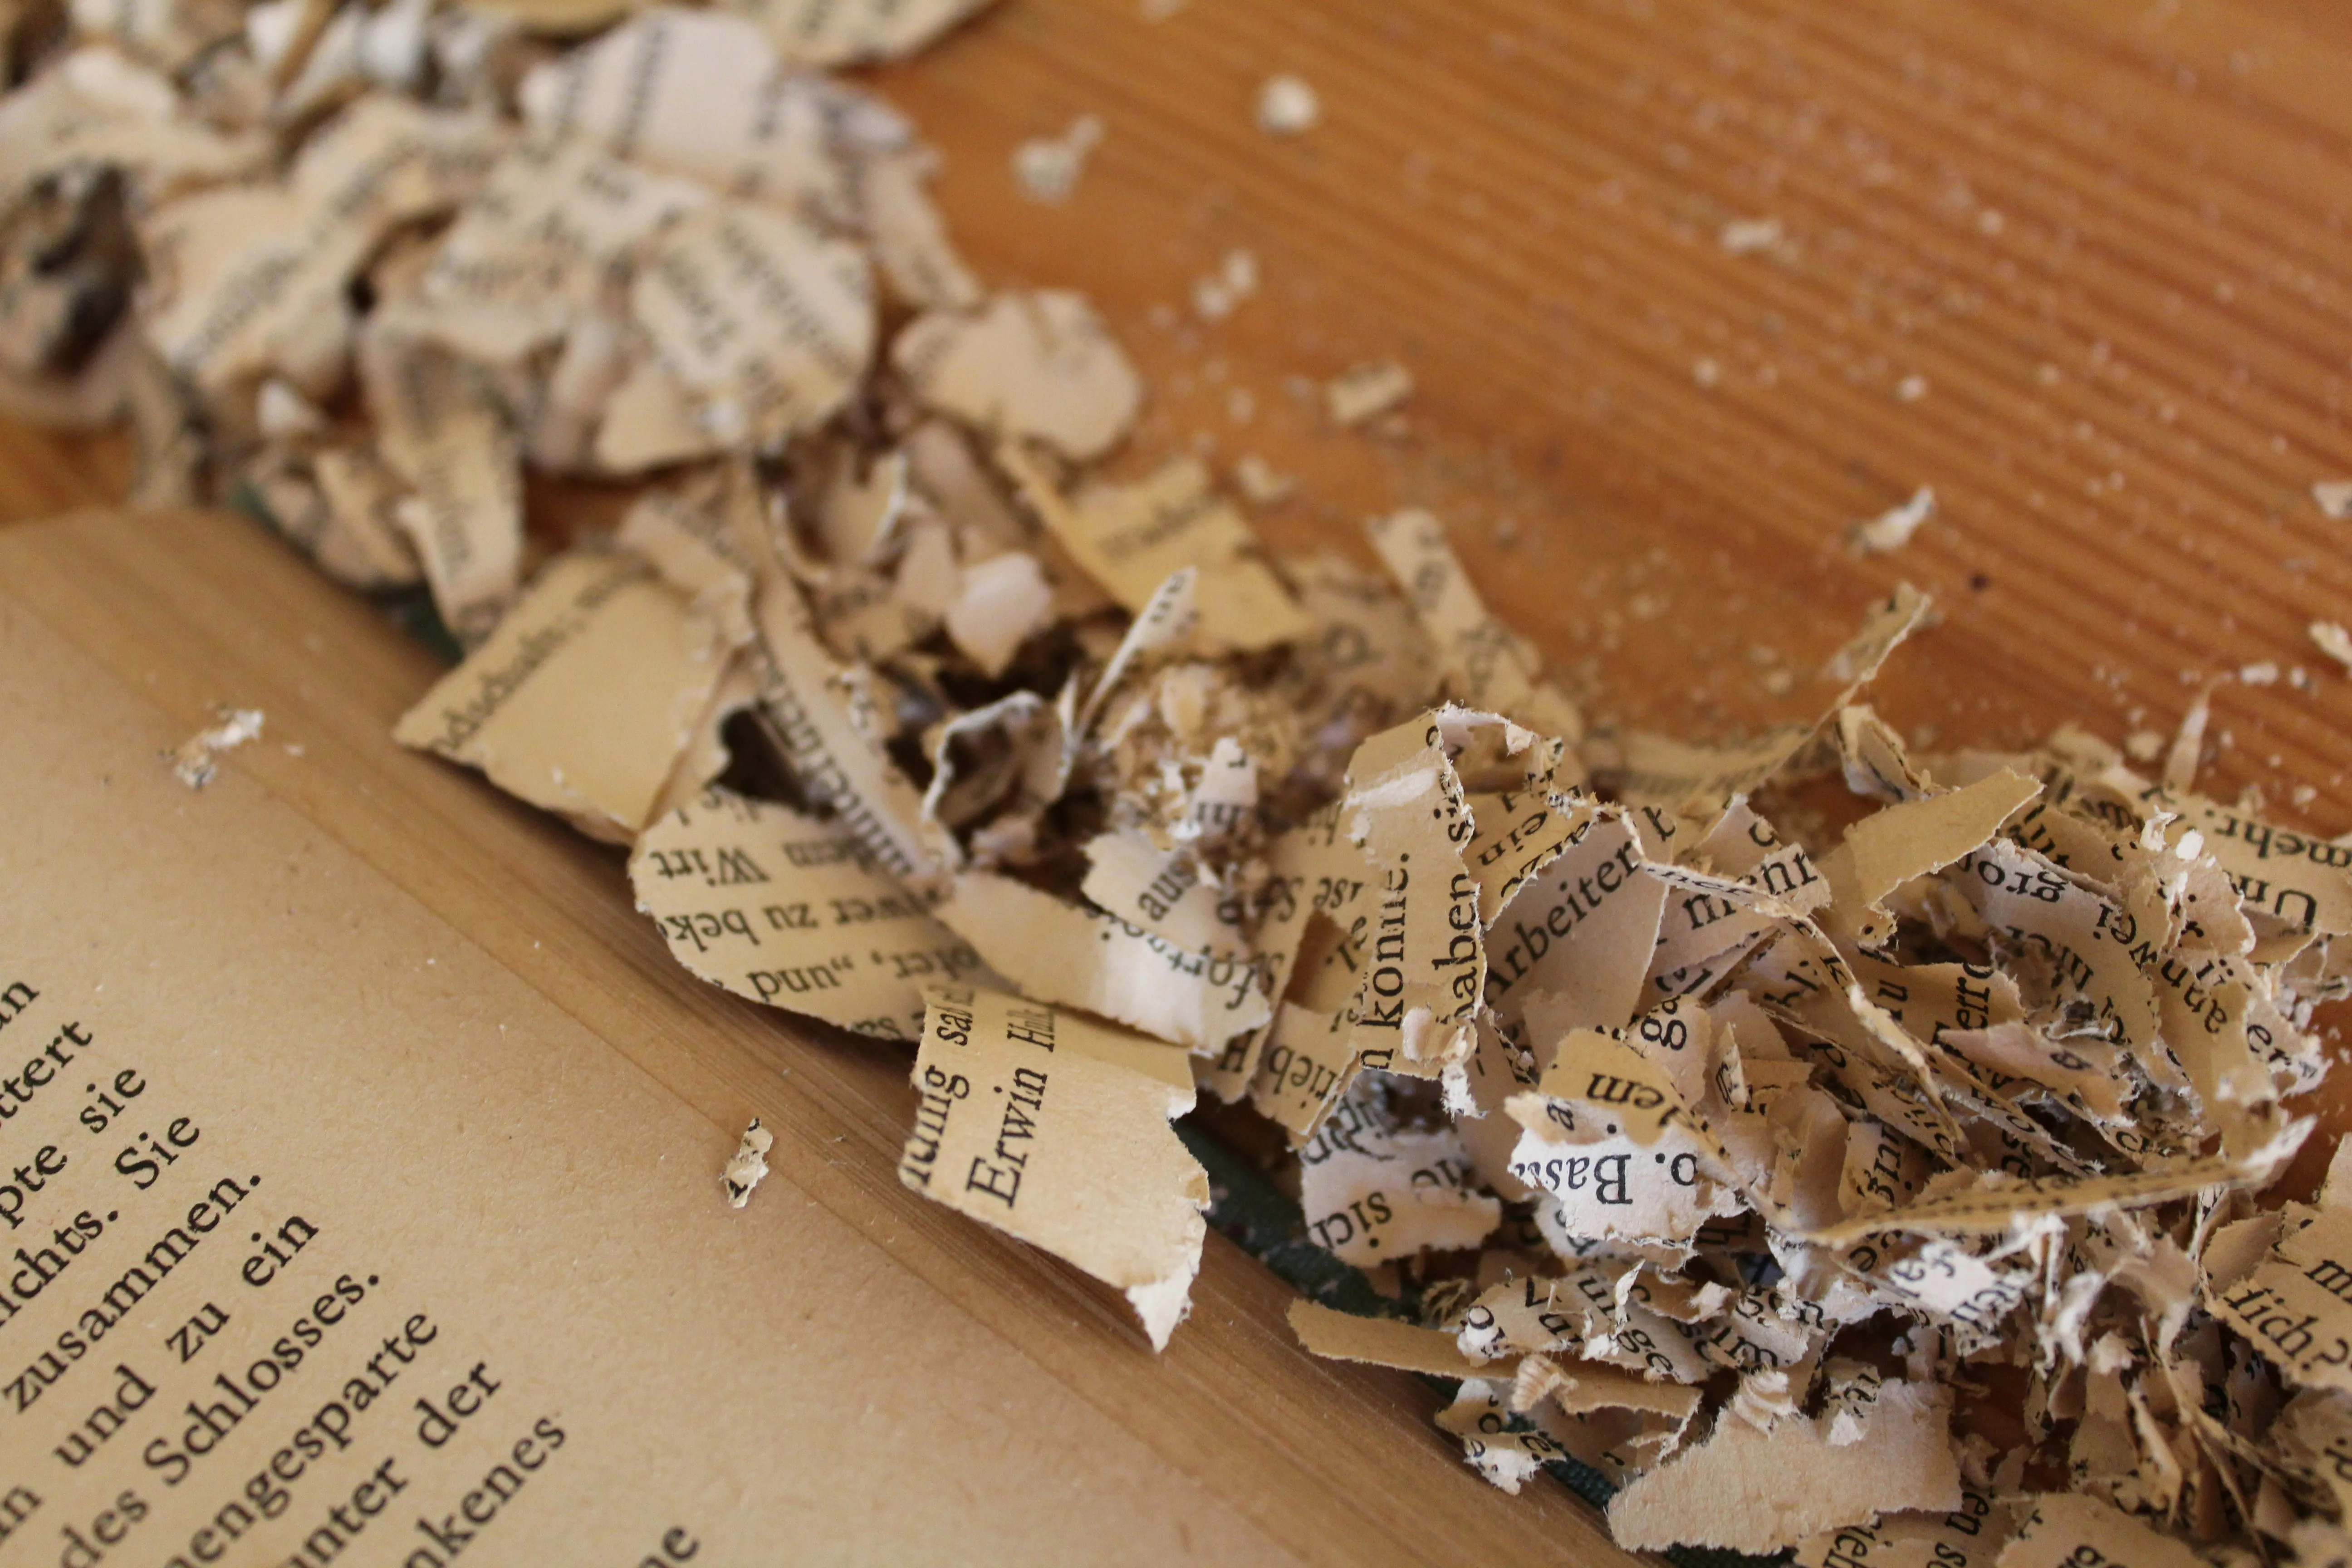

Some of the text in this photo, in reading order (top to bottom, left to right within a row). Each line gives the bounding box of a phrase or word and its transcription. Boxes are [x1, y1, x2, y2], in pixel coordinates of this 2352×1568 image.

[649, 846, 770, 887] Wirt
[80, 1069, 147, 1134] sie
[114, 1116, 200, 1191] Sie
[965, 1066, 1049, 1209] Erwin
[2, 1175, 262, 1415] zusammen.
[52, 1362, 158, 1470] und
[164, 1301, 231, 1365] zu
[241, 1214, 320, 1287] ein
[60, 1273, 381, 1568] des Schlosses.
[413, 1360, 502, 1450] der
